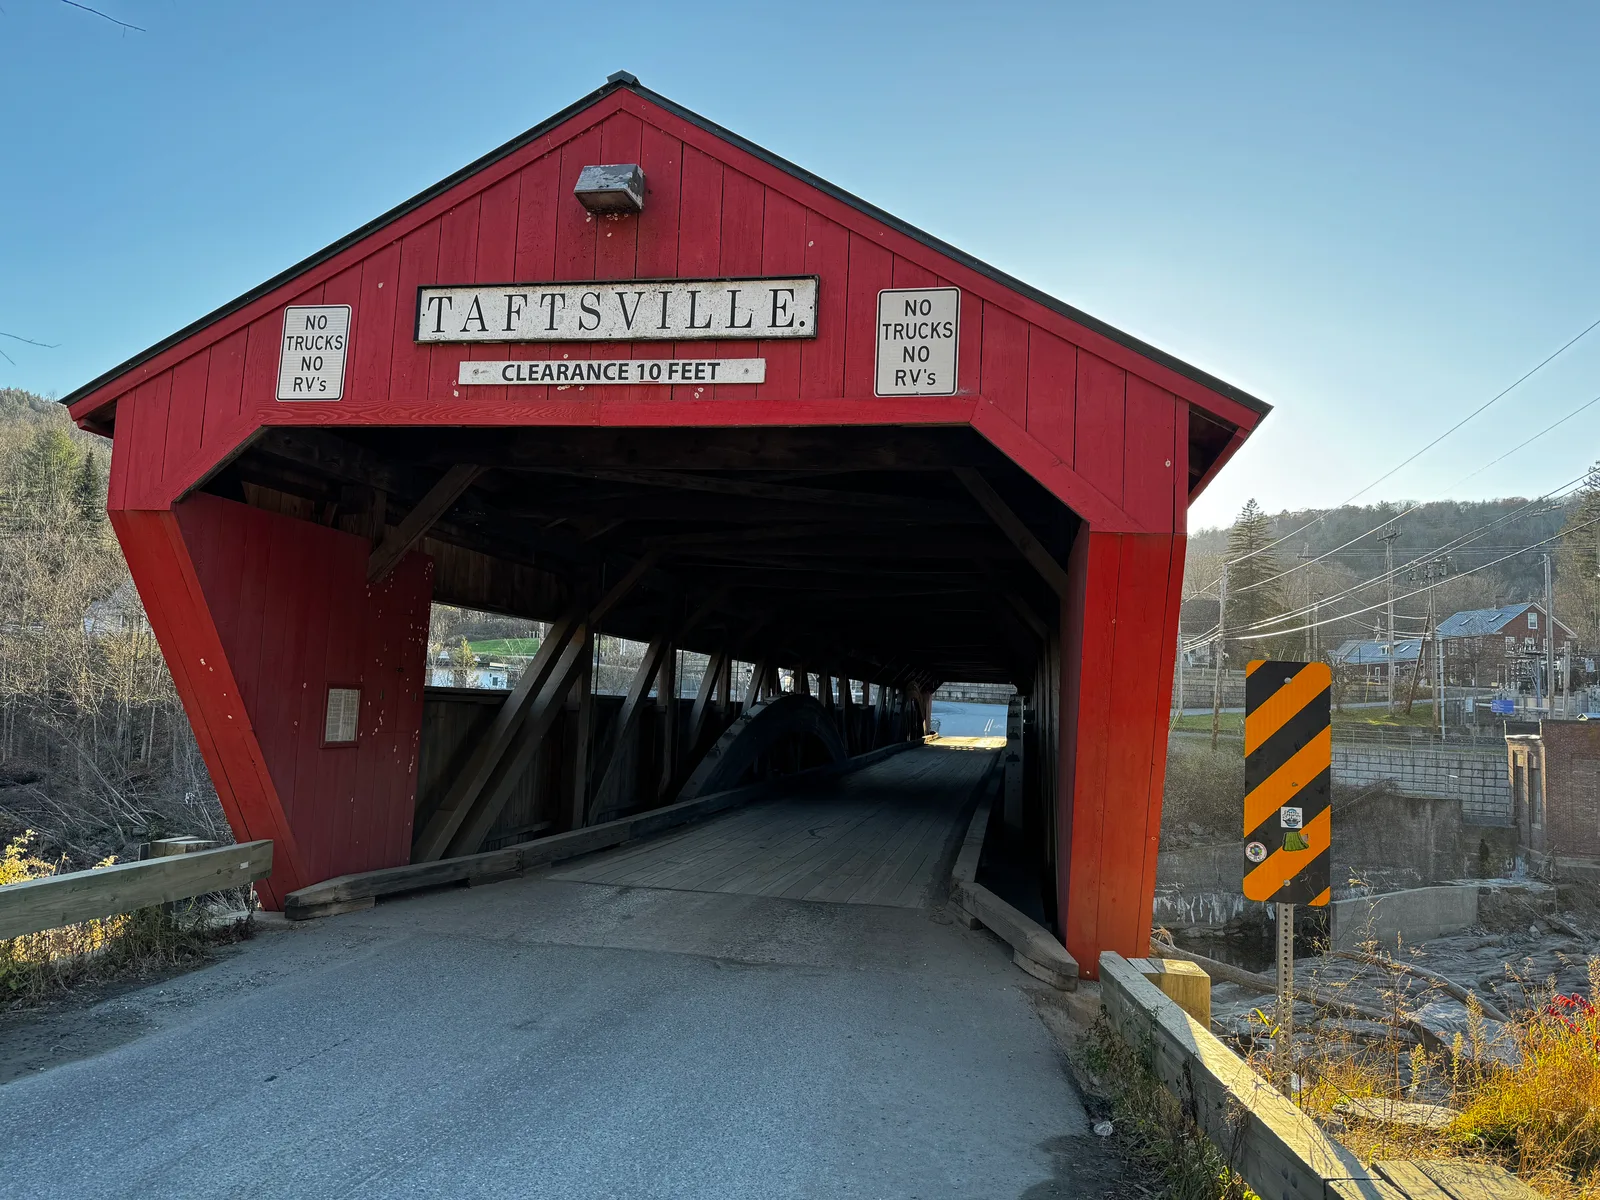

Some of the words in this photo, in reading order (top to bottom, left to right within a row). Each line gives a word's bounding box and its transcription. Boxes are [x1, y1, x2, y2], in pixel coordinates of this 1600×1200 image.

[427, 288, 806, 333] TAFTSVILLE.
[904, 299, 931, 316] NO
[305, 315, 328, 330] NO
[882, 322, 953, 340] TRUCKS
[286, 336, 343, 350] TRUCKS
[903, 346, 930, 362] NO
[301, 356, 324, 371] NO
[502, 363, 629, 382] CLEARANCE
[637, 363, 660, 380] 10
[667, 362, 720, 380] FEET
[895, 369, 936, 386] RV's
[293, 376, 326, 392] RV's
